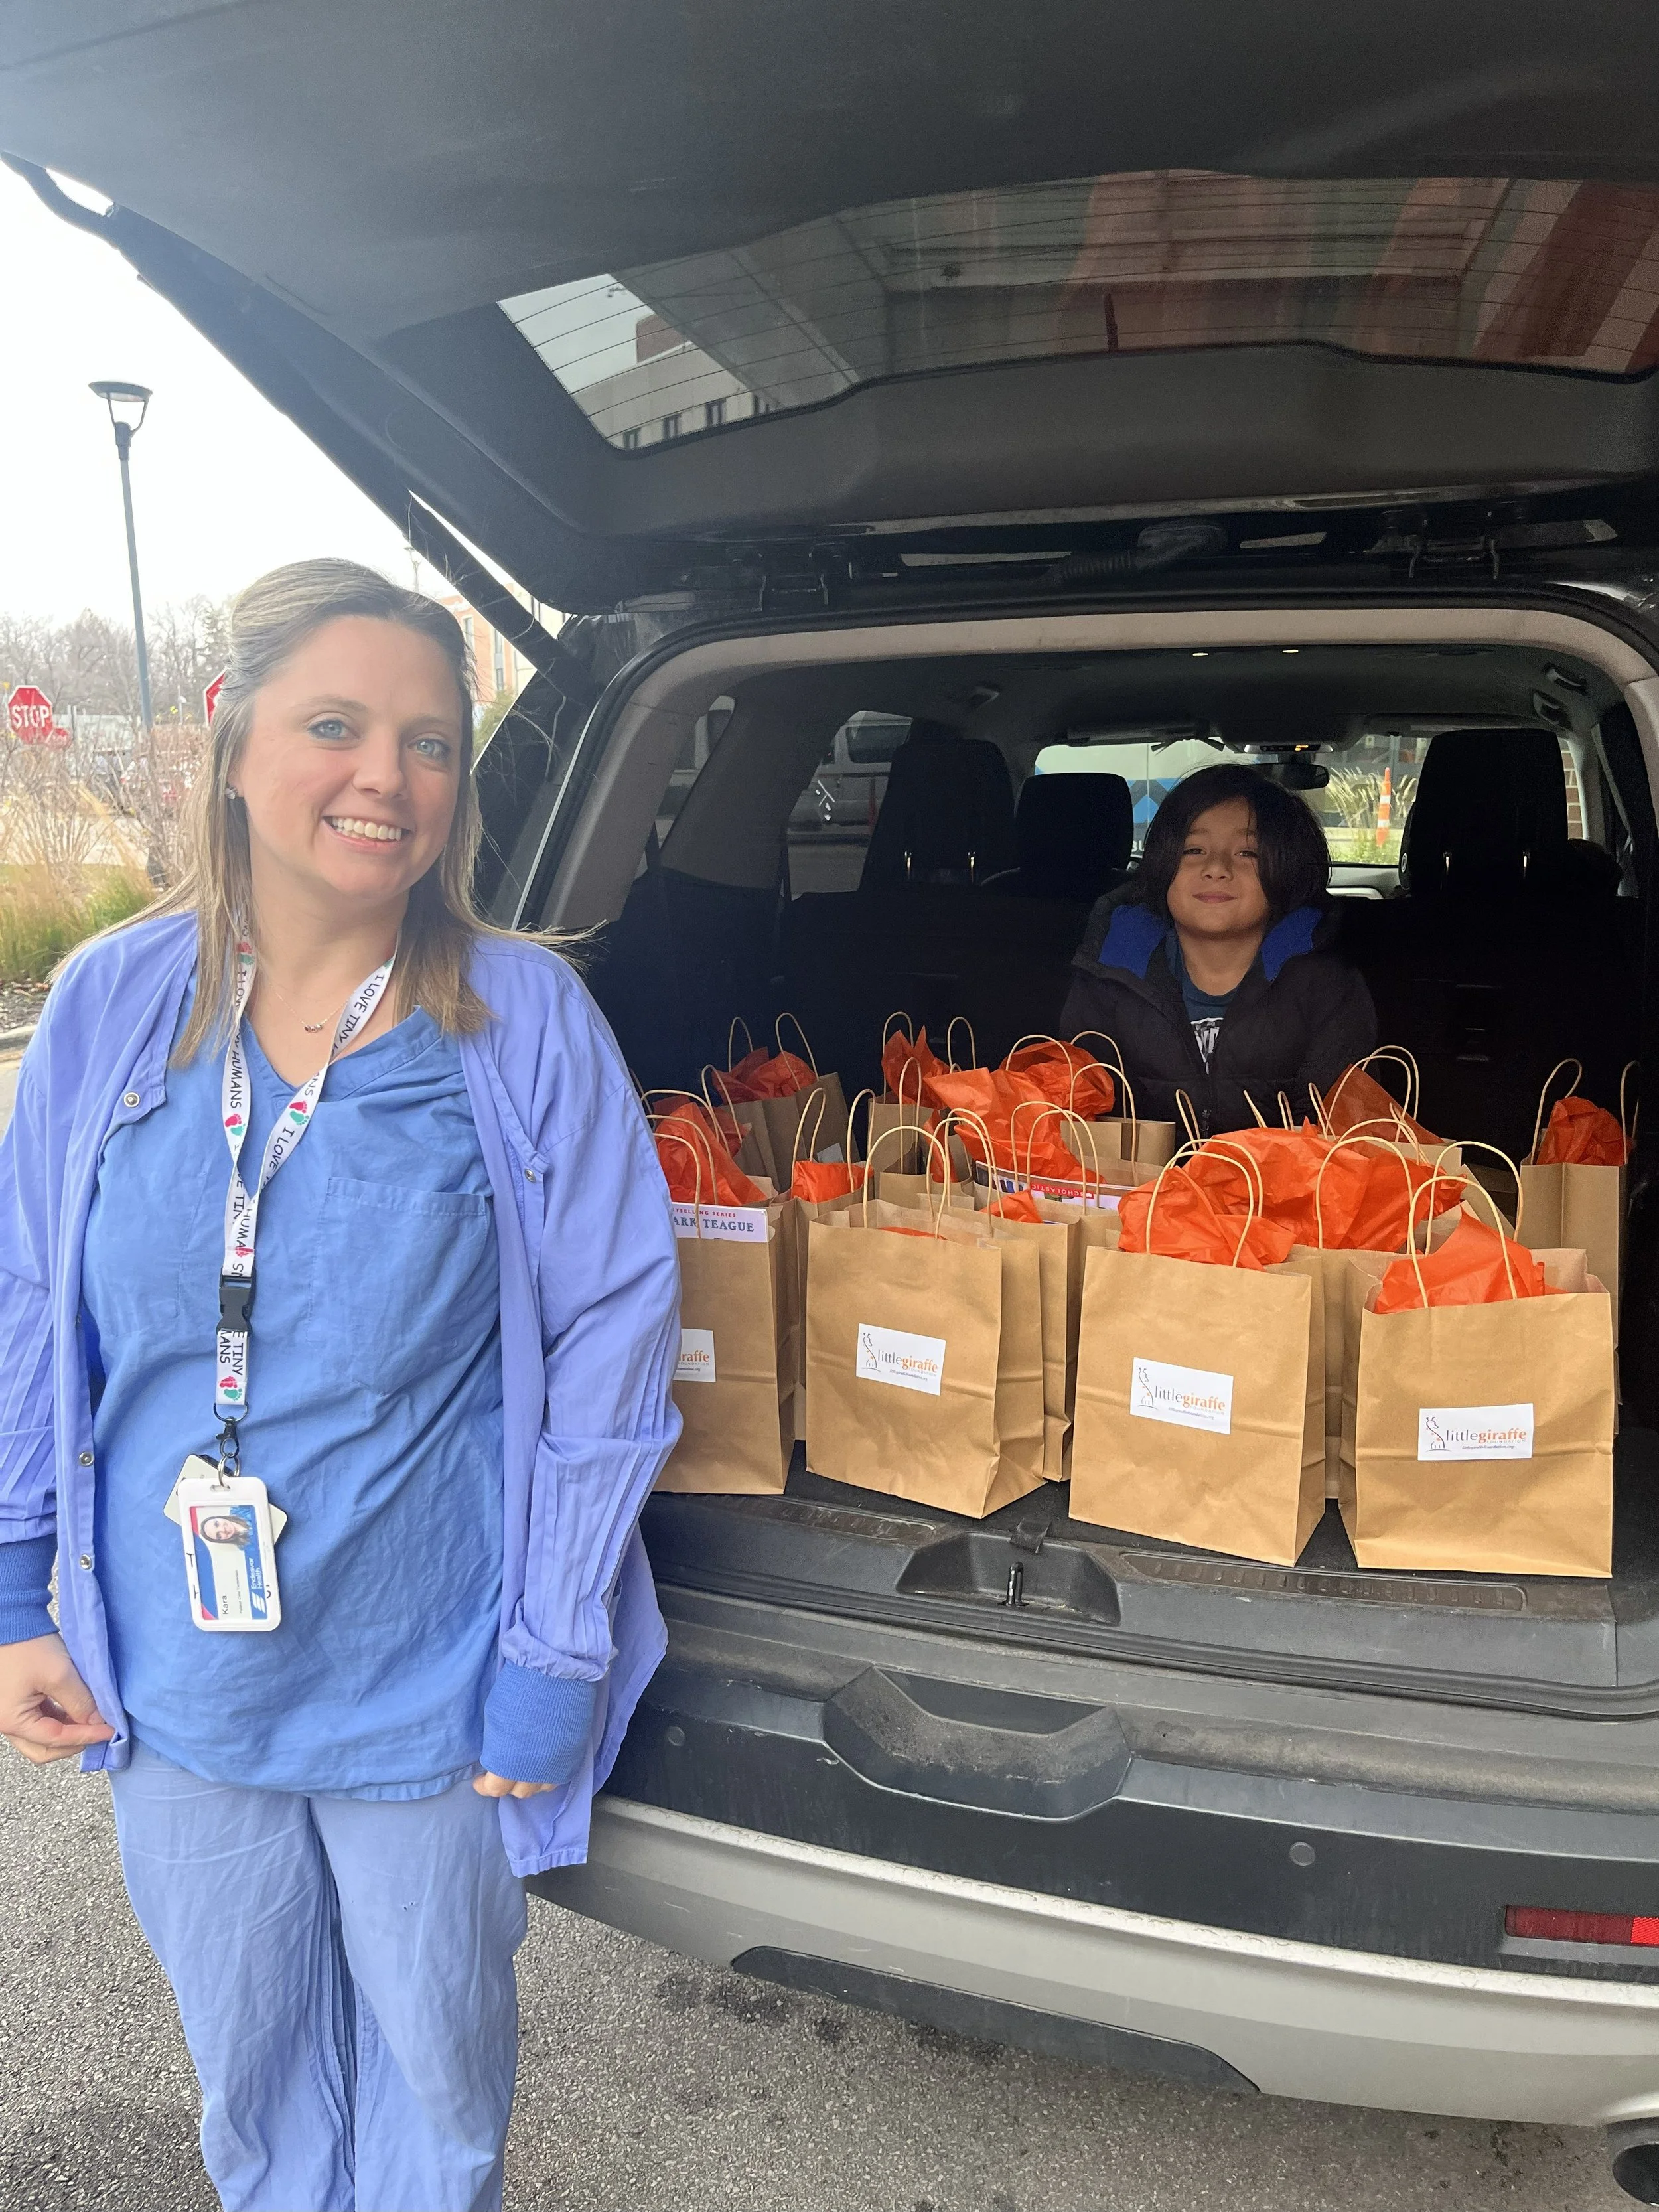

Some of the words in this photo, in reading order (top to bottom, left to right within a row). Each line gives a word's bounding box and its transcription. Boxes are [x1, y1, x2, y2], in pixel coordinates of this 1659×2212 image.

[11, 705, 50, 727] STOP
[354, 983, 380, 1013] LOVE
[333, 1014, 361, 1043] TINY
[230, 1050, 243, 1109] HUMANS
[282, 1126, 295, 1138] I
[269, 1136, 289, 1172] LOVE
[1031, 1184, 1084, 1197] SCHOLASTIC
[233, 1194, 245, 1224] TIN
[674, 1216, 697, 1228] ARK
[702, 1218, 755, 1232] TEAGUE
[232, 1342, 244, 1376] TINY
[877, 1349, 938, 1373] littlegiraffe
[1155, 1385, 1226, 1411] littlegiraffe
[1446, 1428, 1527, 1444] littlegiraffe
[248, 1557, 257, 1589] Endeavor
